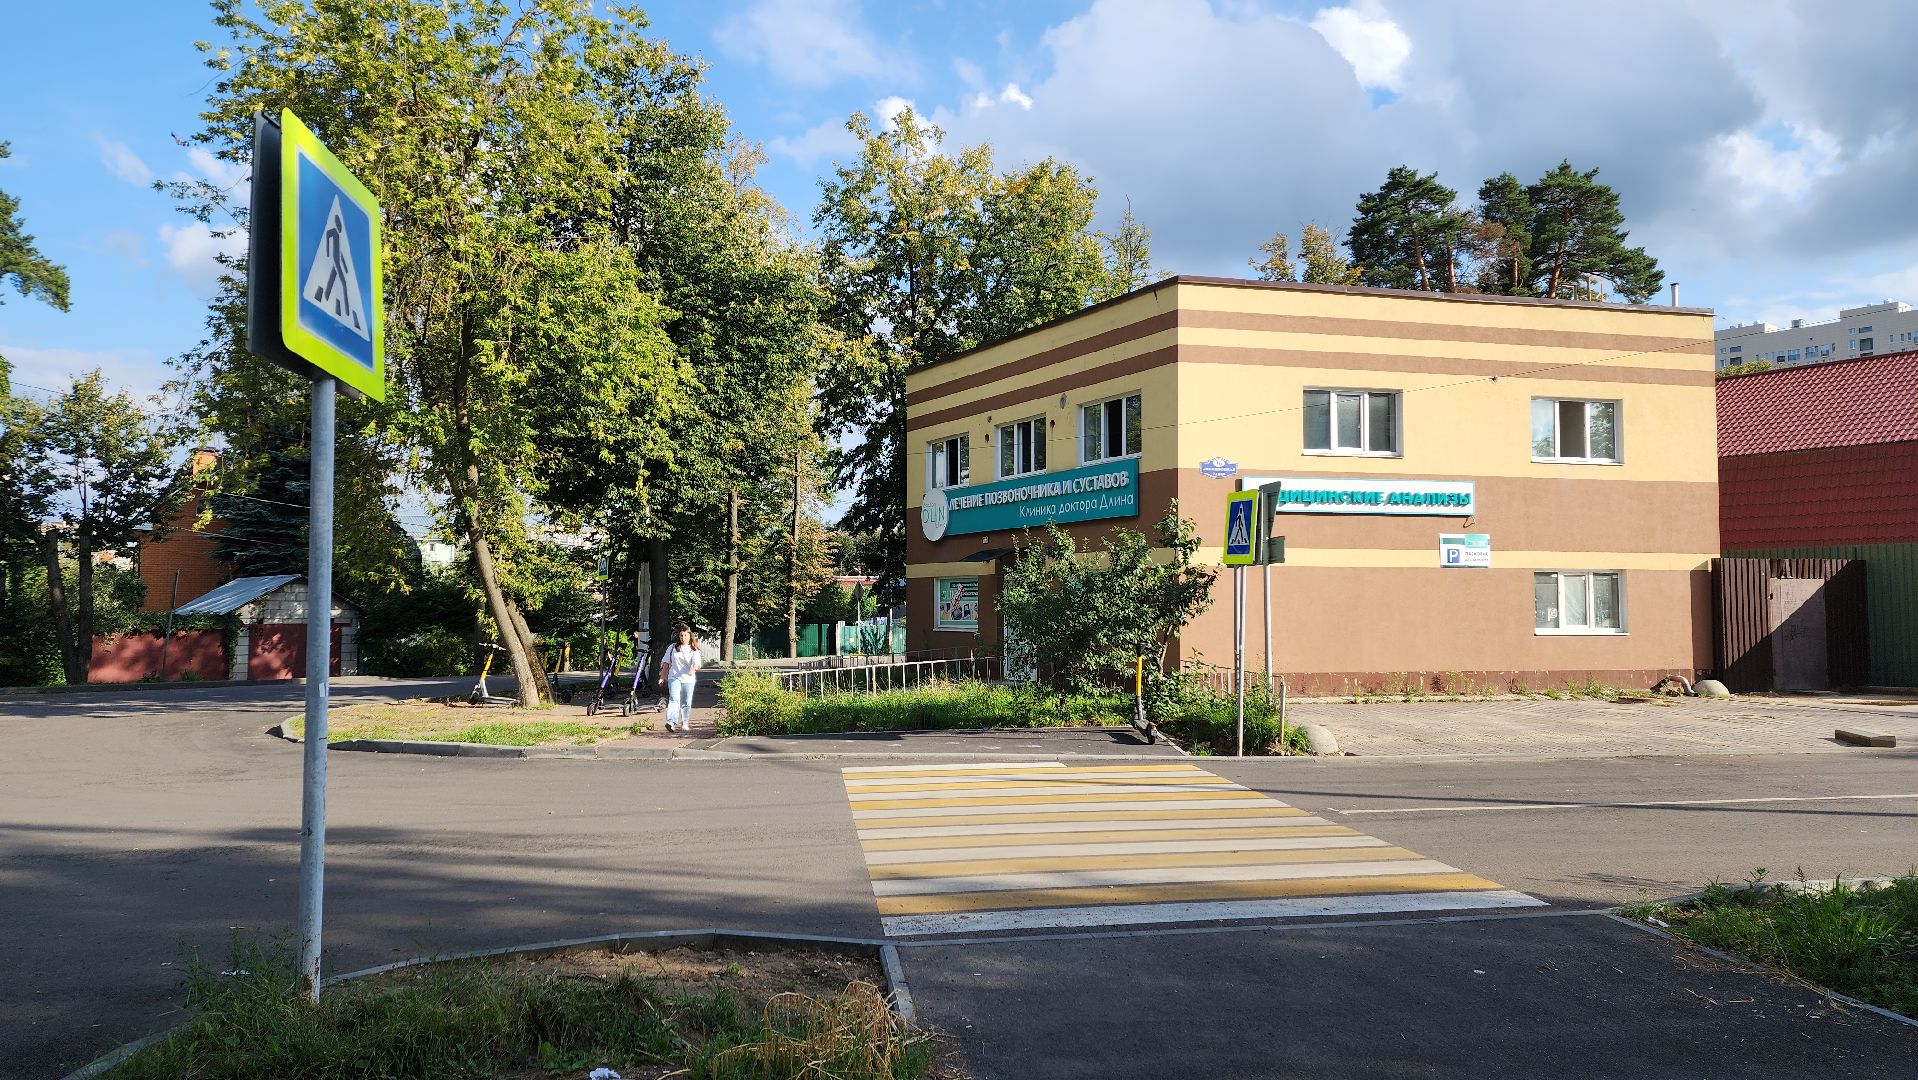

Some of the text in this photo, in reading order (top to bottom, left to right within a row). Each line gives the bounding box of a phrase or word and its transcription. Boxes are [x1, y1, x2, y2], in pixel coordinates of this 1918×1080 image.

[949, 470, 1129, 511] ЛЕЧЕНИЕ ПОЗВОНОЧНИКА И СУСТАВОВ
[1279, 489, 1471, 506] ДИЦИНСКИЕ АНАЛИЗЫ
[1020, 493, 1134, 518] Клиника доктора Длина
